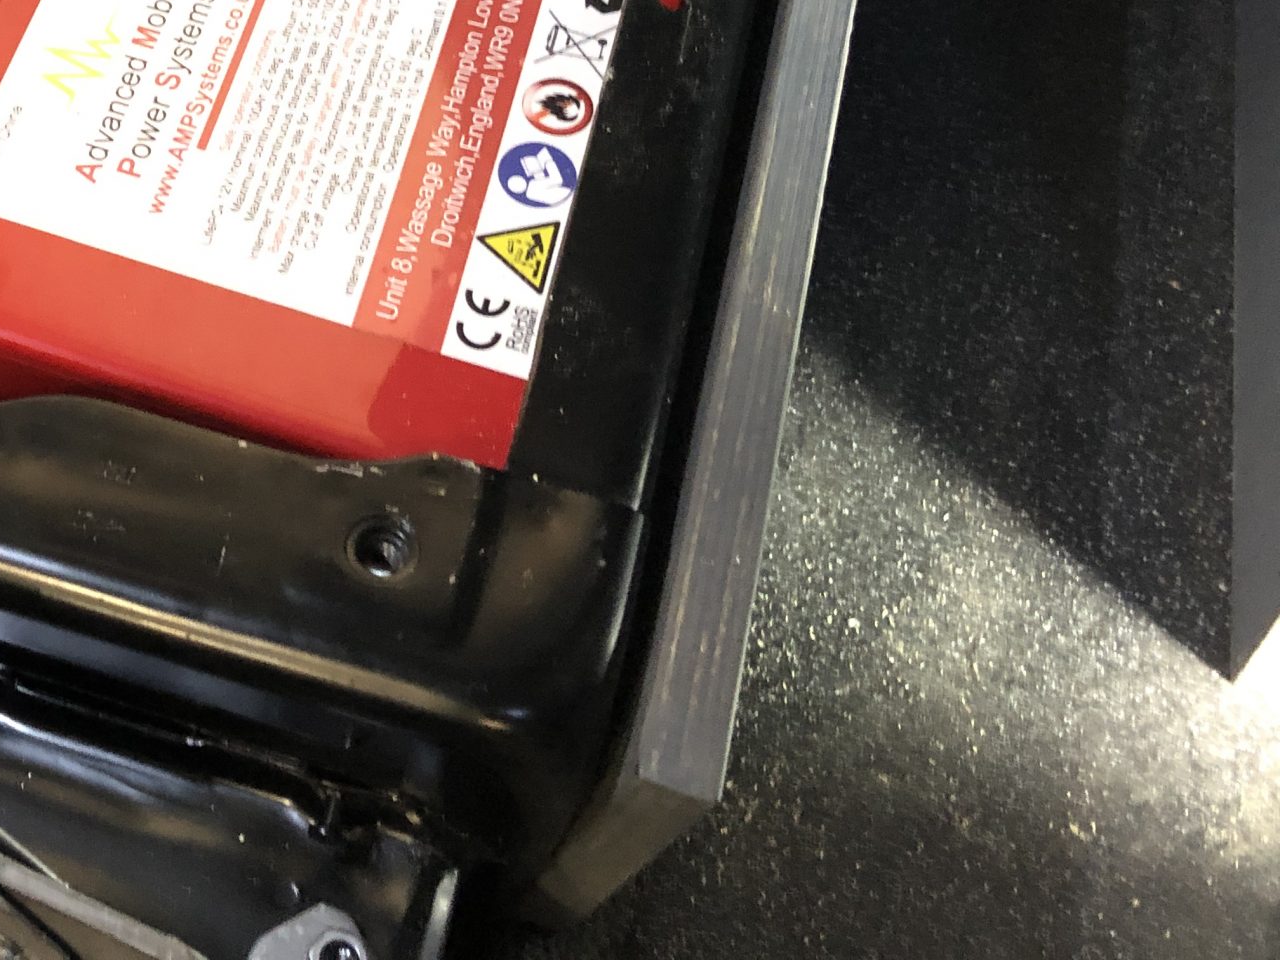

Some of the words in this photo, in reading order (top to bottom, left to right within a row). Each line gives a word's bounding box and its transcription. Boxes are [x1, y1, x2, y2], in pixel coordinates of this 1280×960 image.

[70, 54, 148, 184] Advanced
[115, 94, 173, 178] Power
[374, 273, 409, 322] Unit
[450, 287, 511, 355] CE
[504, 304, 531, 352] RoHS
